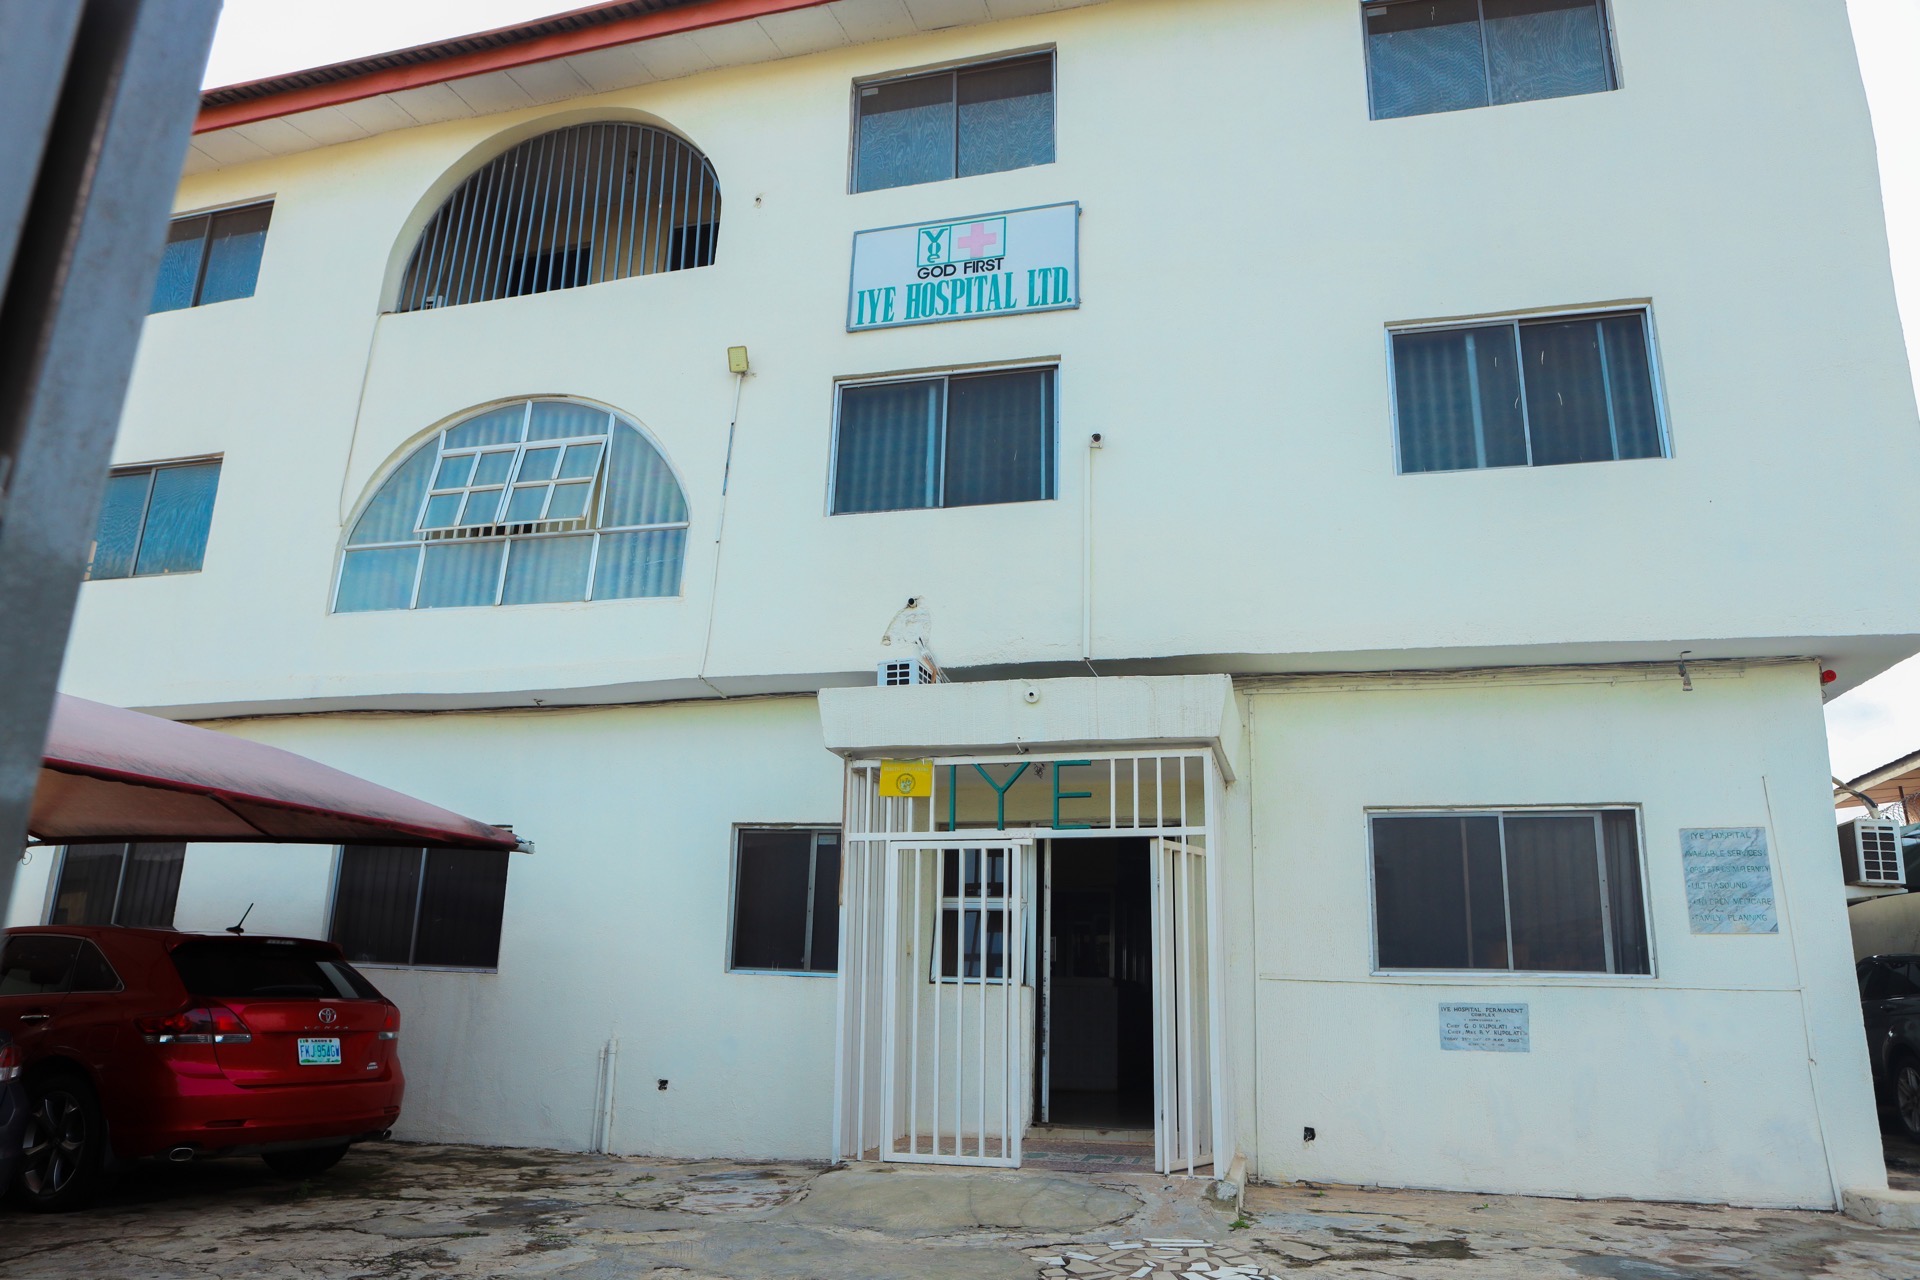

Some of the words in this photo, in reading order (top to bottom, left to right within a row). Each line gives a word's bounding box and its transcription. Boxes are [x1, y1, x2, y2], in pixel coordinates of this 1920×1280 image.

[917, 263, 957, 280] GOD
[963, 257, 1004, 275] FIRST
[855, 286, 896, 326] IYE
[904, 271, 1017, 320] HOSPITAL
[1026, 266, 1073, 308] LTD.
[1690, 832, 1705, 840] IYE
[1711, 831, 1752, 840] HOSPITAL
[1684, 850, 1726, 858] AVAILABLE
[1691, 881, 1748, 890] ULTRASOUND
[1695, 914, 1722, 922] FAMILY
[1727, 914, 1768, 922] PLANNING
